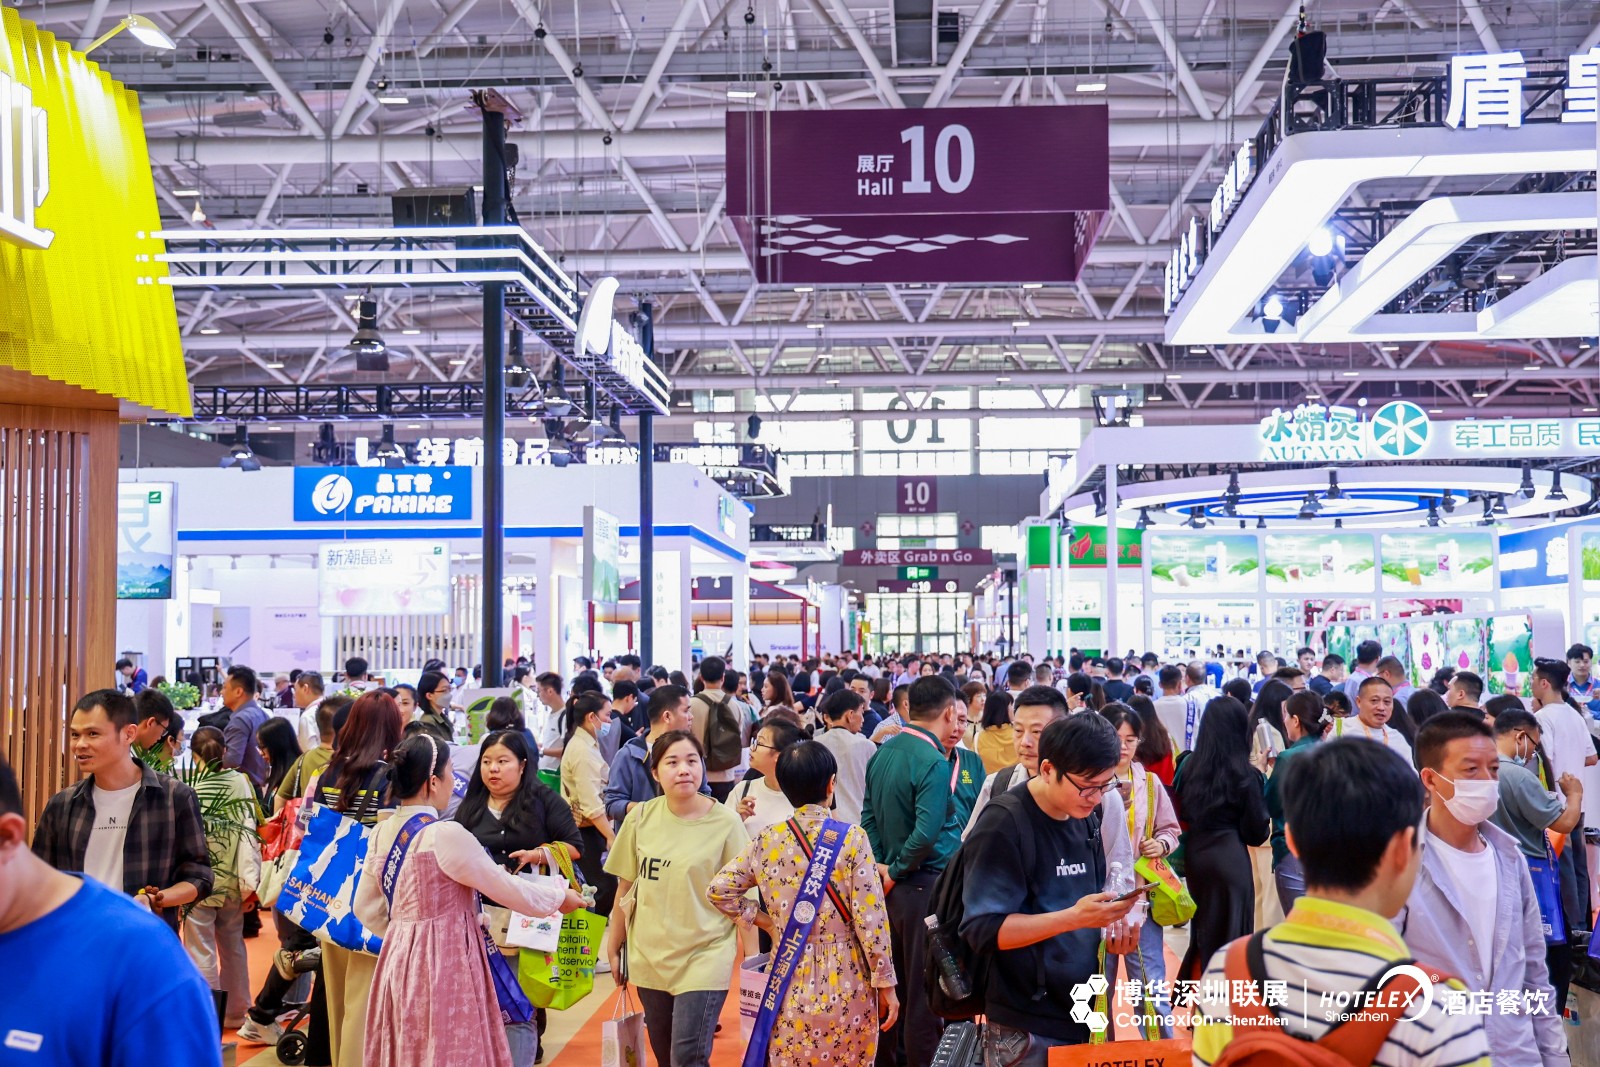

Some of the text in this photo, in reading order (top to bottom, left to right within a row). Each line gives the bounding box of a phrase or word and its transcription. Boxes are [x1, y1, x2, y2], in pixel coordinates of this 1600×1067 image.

[857, 154, 895, 174] 展厅
[900, 123, 976, 194] 10
[857, 178, 893, 196] Hall
[1455, 422, 1561, 448] 军工品质
[903, 481, 931, 505] 10
[355, 495, 453, 514] PAXIKE
[861, 550, 973, 564] 外卖区 Grab n Go
[109, 816, 116, 824] N
[803, 846, 833, 898] 开餐饮
